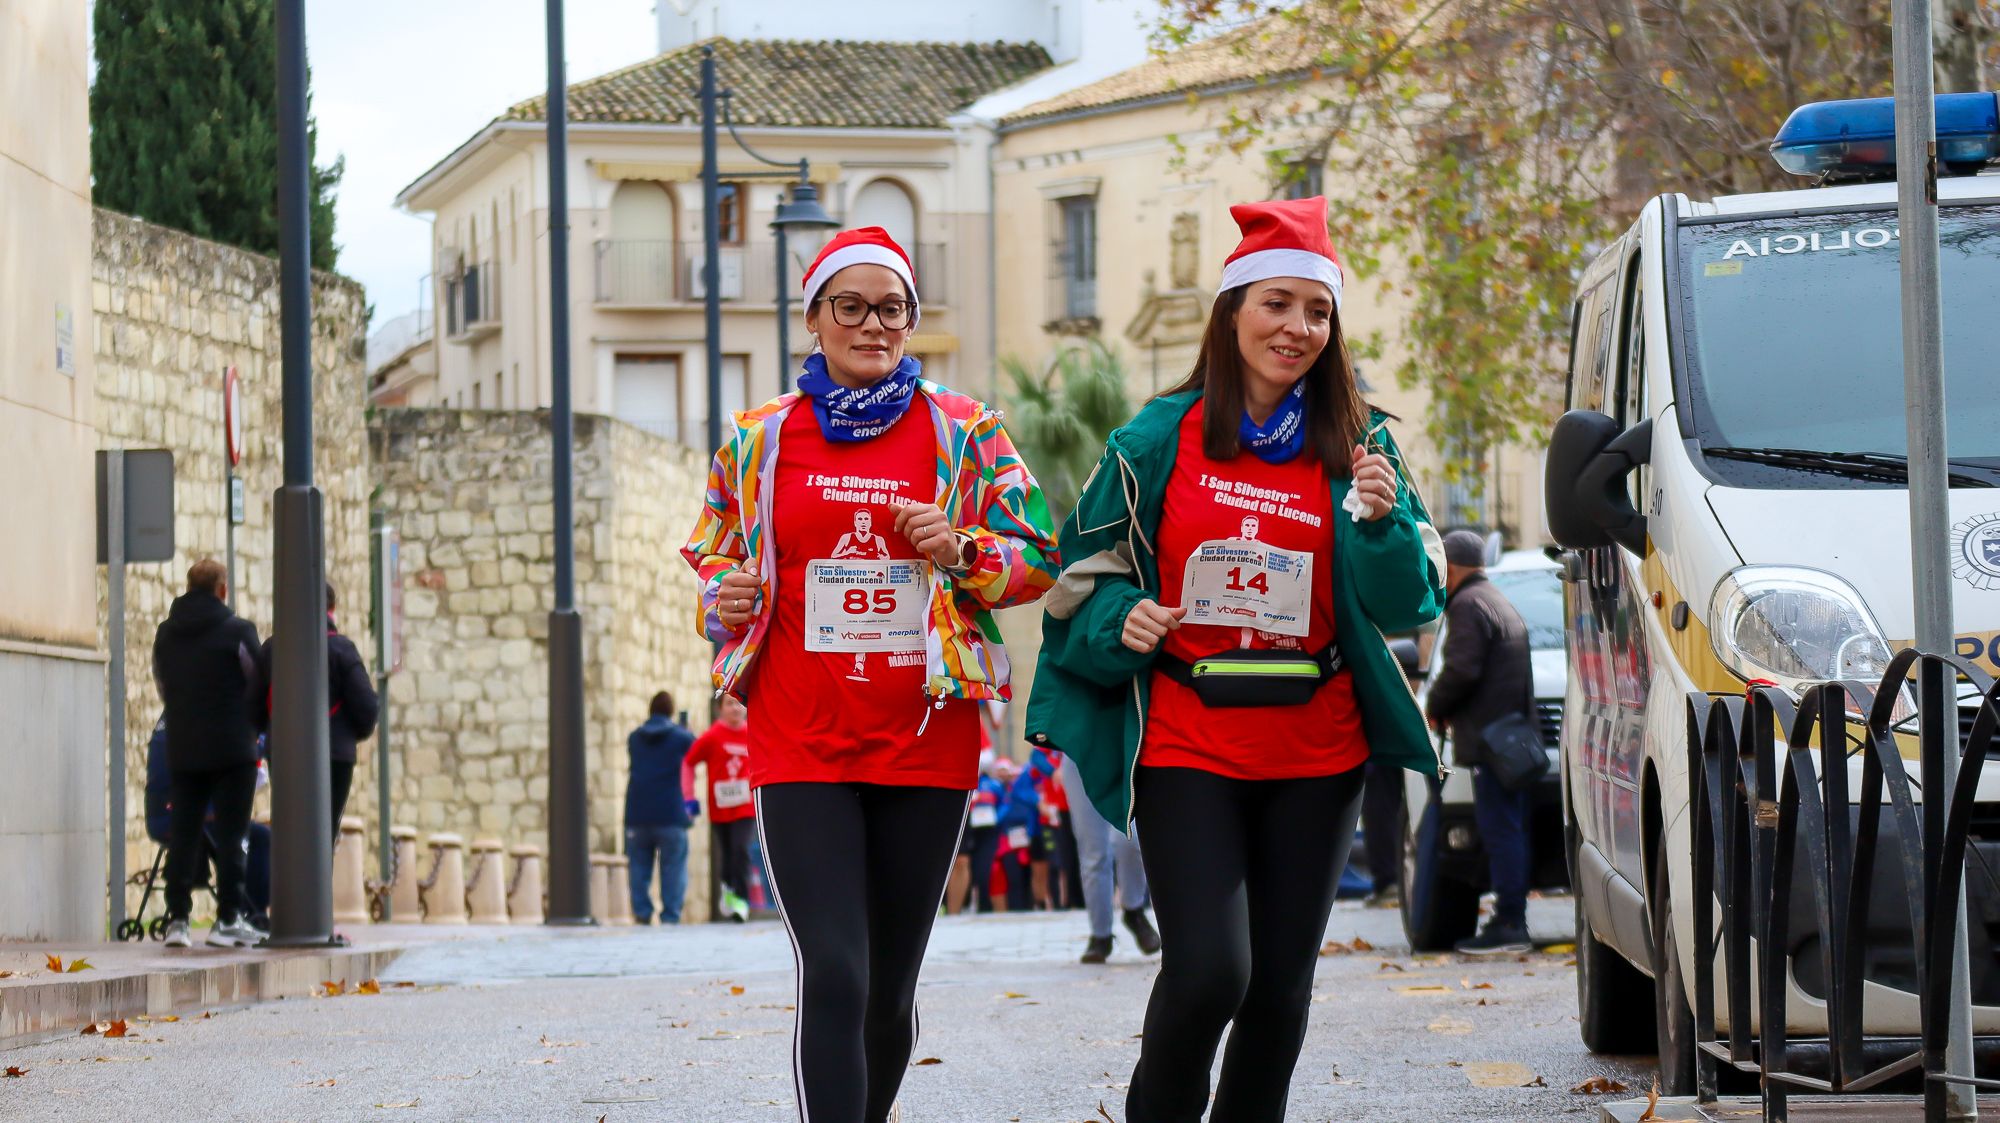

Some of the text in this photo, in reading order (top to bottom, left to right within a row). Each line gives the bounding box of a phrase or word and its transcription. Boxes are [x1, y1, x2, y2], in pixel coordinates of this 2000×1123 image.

[806, 475, 814, 486] I
[815, 475, 839, 487] San
[841, 476, 899, 491] Silvestre
[1199, 474, 1208, 487] I
[1208, 476, 1233, 492] San
[1234, 481, 1290, 504] Silvestre
[822, 488, 868, 504] Ciudad
[870, 492, 888, 505] de
[1214, 491, 1322, 528] Ciudad de Lucena
[1216, 547, 1250, 556] Silvestre
[1237, 555, 1262, 567] Lucena
[819, 568, 833, 576] San
[834, 568, 868, 577] Silvestre
[818, 576, 844, 584] Ciudad
[1225, 566, 1269, 596] 14
[842, 588, 897, 614] 85
[1263, 612, 1297, 621] enerplus
[841, 631, 860, 640] vtv
[888, 628, 920, 637] enerplus
